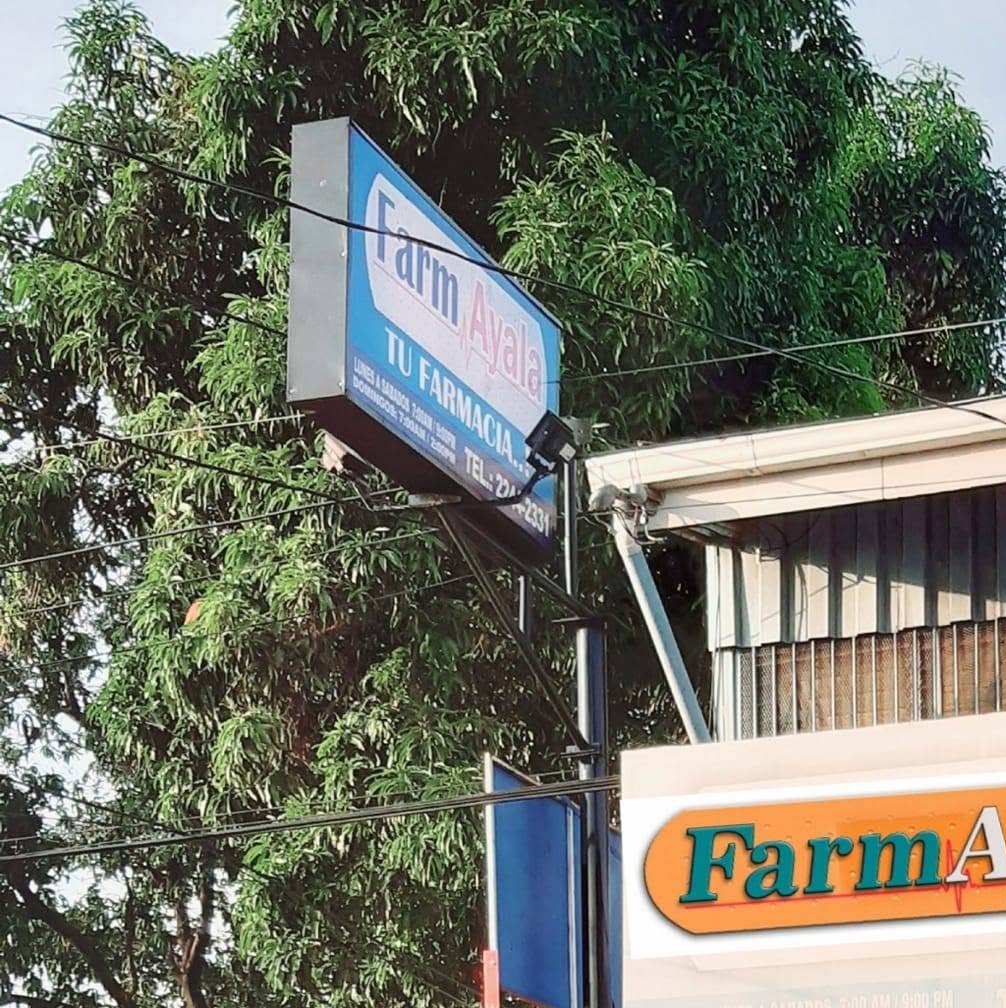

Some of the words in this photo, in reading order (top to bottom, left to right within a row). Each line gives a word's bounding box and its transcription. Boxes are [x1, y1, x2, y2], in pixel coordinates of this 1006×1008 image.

[377, 188, 460, 326] Farm
[468, 279, 542, 400] Ayala
[385, 327, 412, 377] TU
